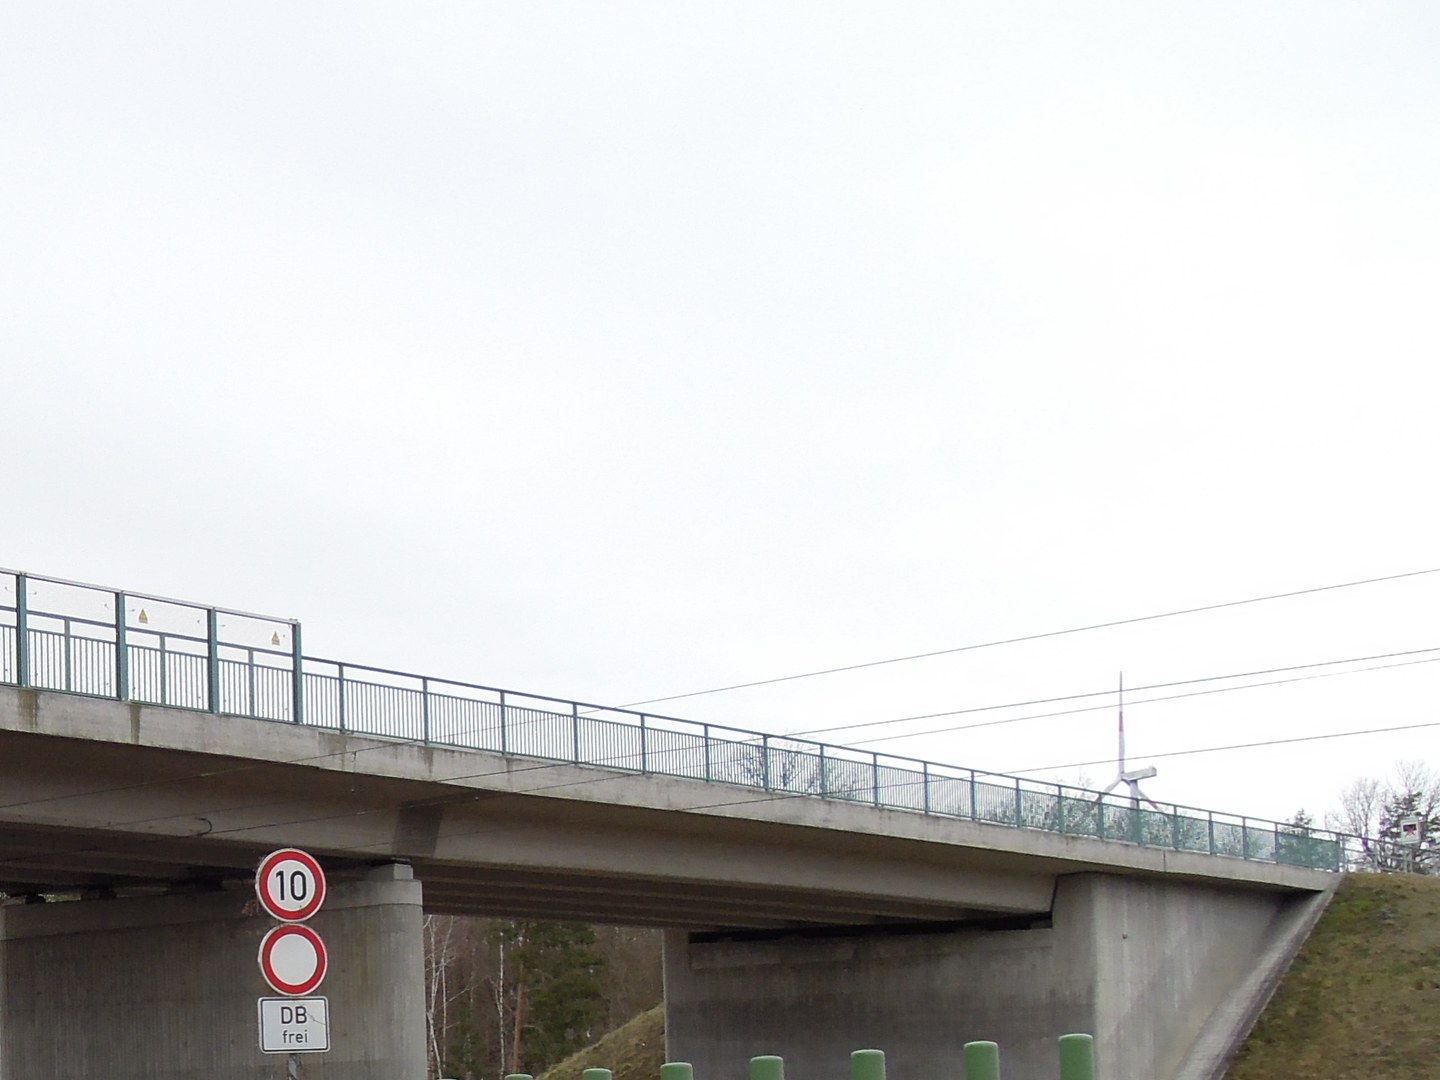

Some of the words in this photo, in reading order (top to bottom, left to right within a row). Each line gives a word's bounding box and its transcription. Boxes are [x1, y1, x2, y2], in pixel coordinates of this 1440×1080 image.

[275, 870, 307, 901] 10
[280, 1006, 308, 1025] DB
[282, 1029, 308, 1044] frei
